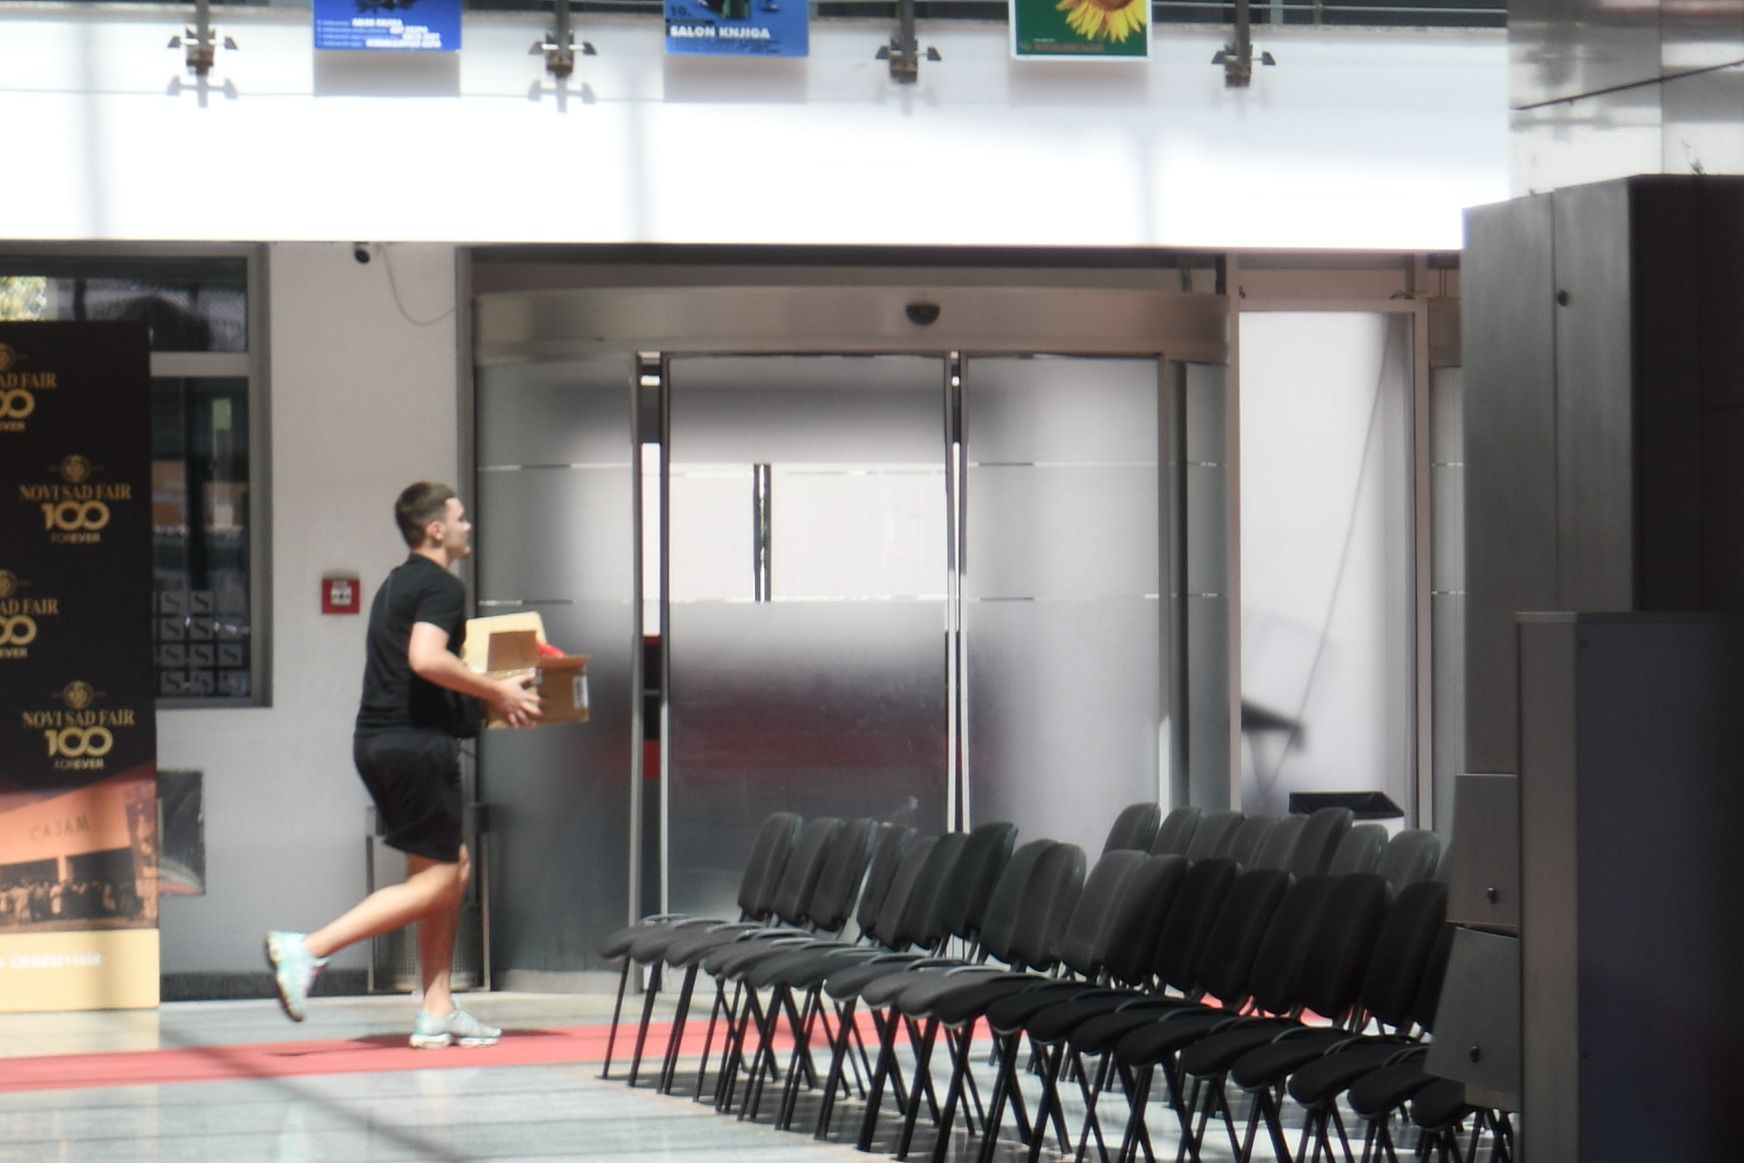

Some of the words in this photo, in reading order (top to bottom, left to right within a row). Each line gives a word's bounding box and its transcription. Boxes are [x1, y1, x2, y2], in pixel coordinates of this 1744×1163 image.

[670, 25, 715, 38] SALON
[719, 27, 770, 39] KNJIGA
[0, 372, 17, 389] AD
[22, 371, 59, 389] FAIR
[0, 421, 26, 431] EVER
[19, 484, 59, 500] NOVI
[62, 484, 93, 500] SAD
[96, 483, 132, 500] FAIR
[41, 500, 110, 530] 100
[51, 532, 101, 544] FOREVER
[0, 598, 19, 615] AD
[23, 598, 59, 615] FAIR
[0, 647, 28, 658] EVER
[21, 711, 61, 727] NOVI
[65, 711, 96, 726] SAD
[99, 709, 135, 726] FAIR
[44, 726, 113, 757] 100
[54, 758, 104, 770] FOREVER
